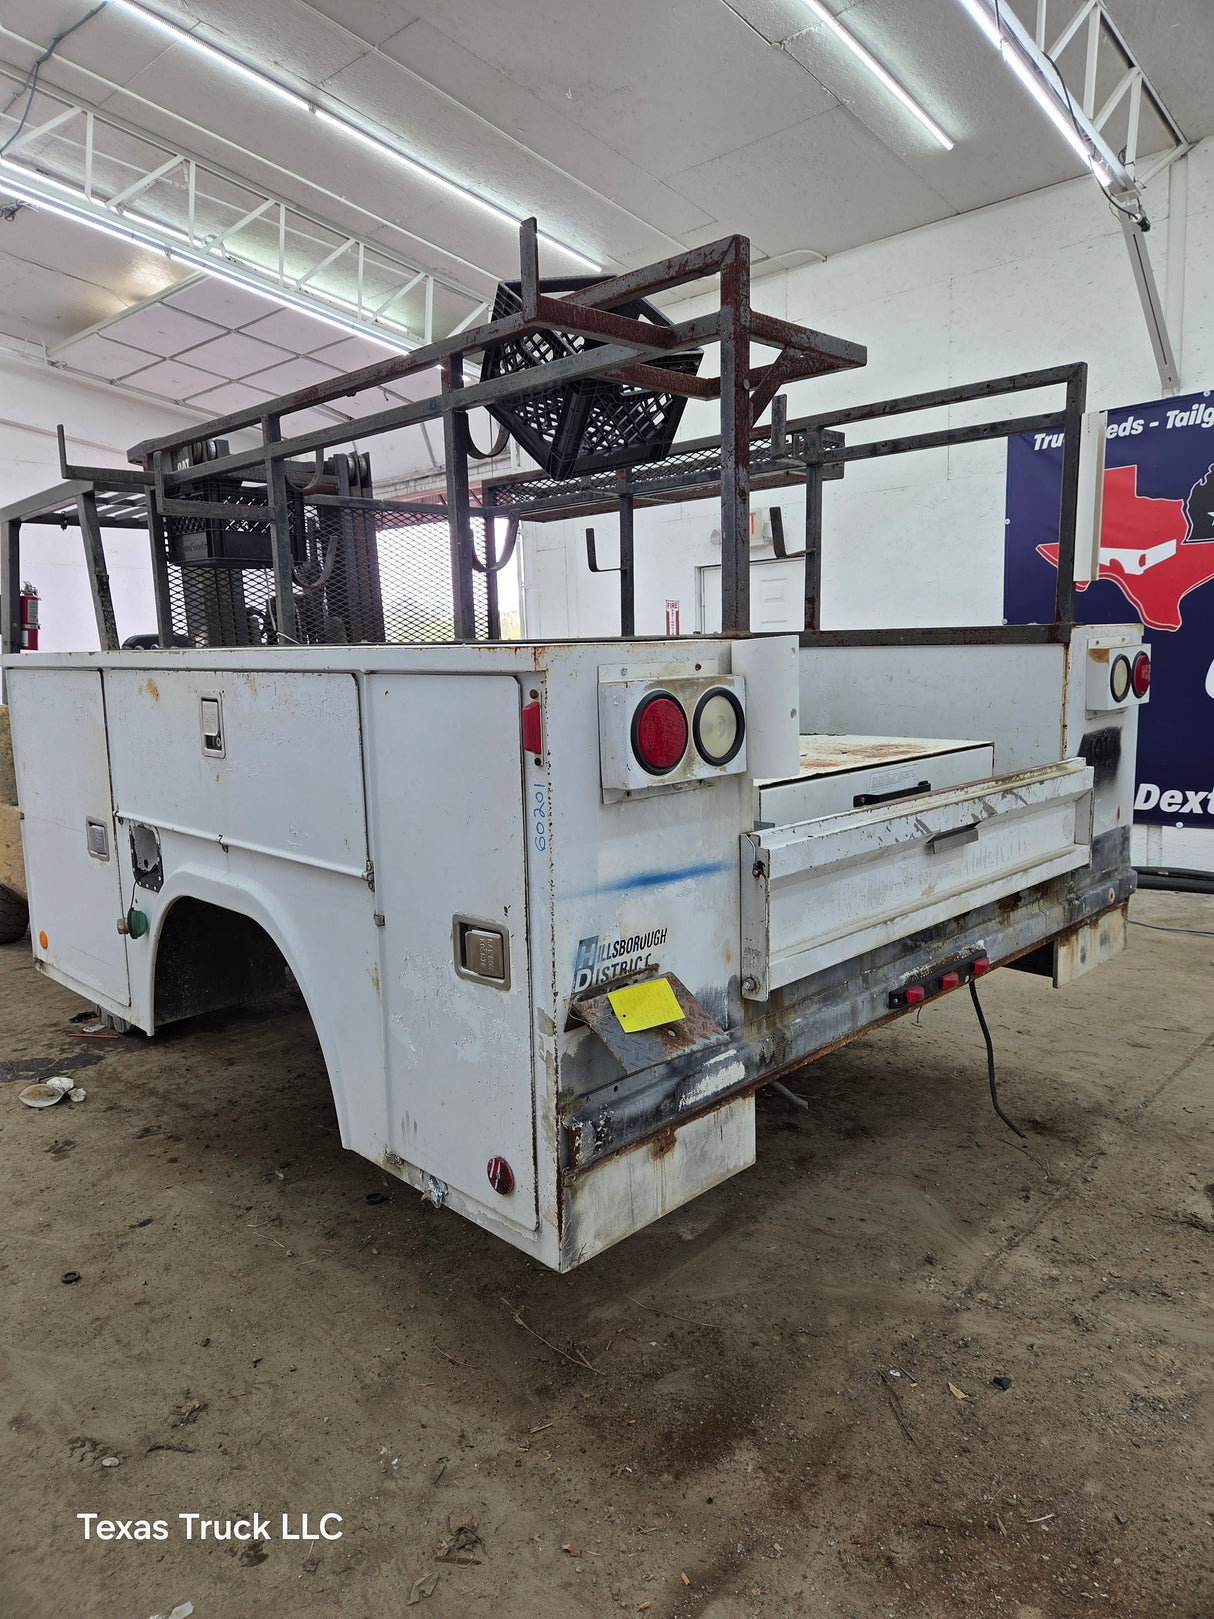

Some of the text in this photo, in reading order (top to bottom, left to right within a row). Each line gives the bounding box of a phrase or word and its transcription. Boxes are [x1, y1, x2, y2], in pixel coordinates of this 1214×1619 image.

[1033, 432, 1065, 451] Tru
[1104, 416, 1145, 440] eds
[667, 601, 678, 609] FIRE
[533, 783, 546, 852] 60201
[578, 928, 668, 969] HILLSBOROUGH
